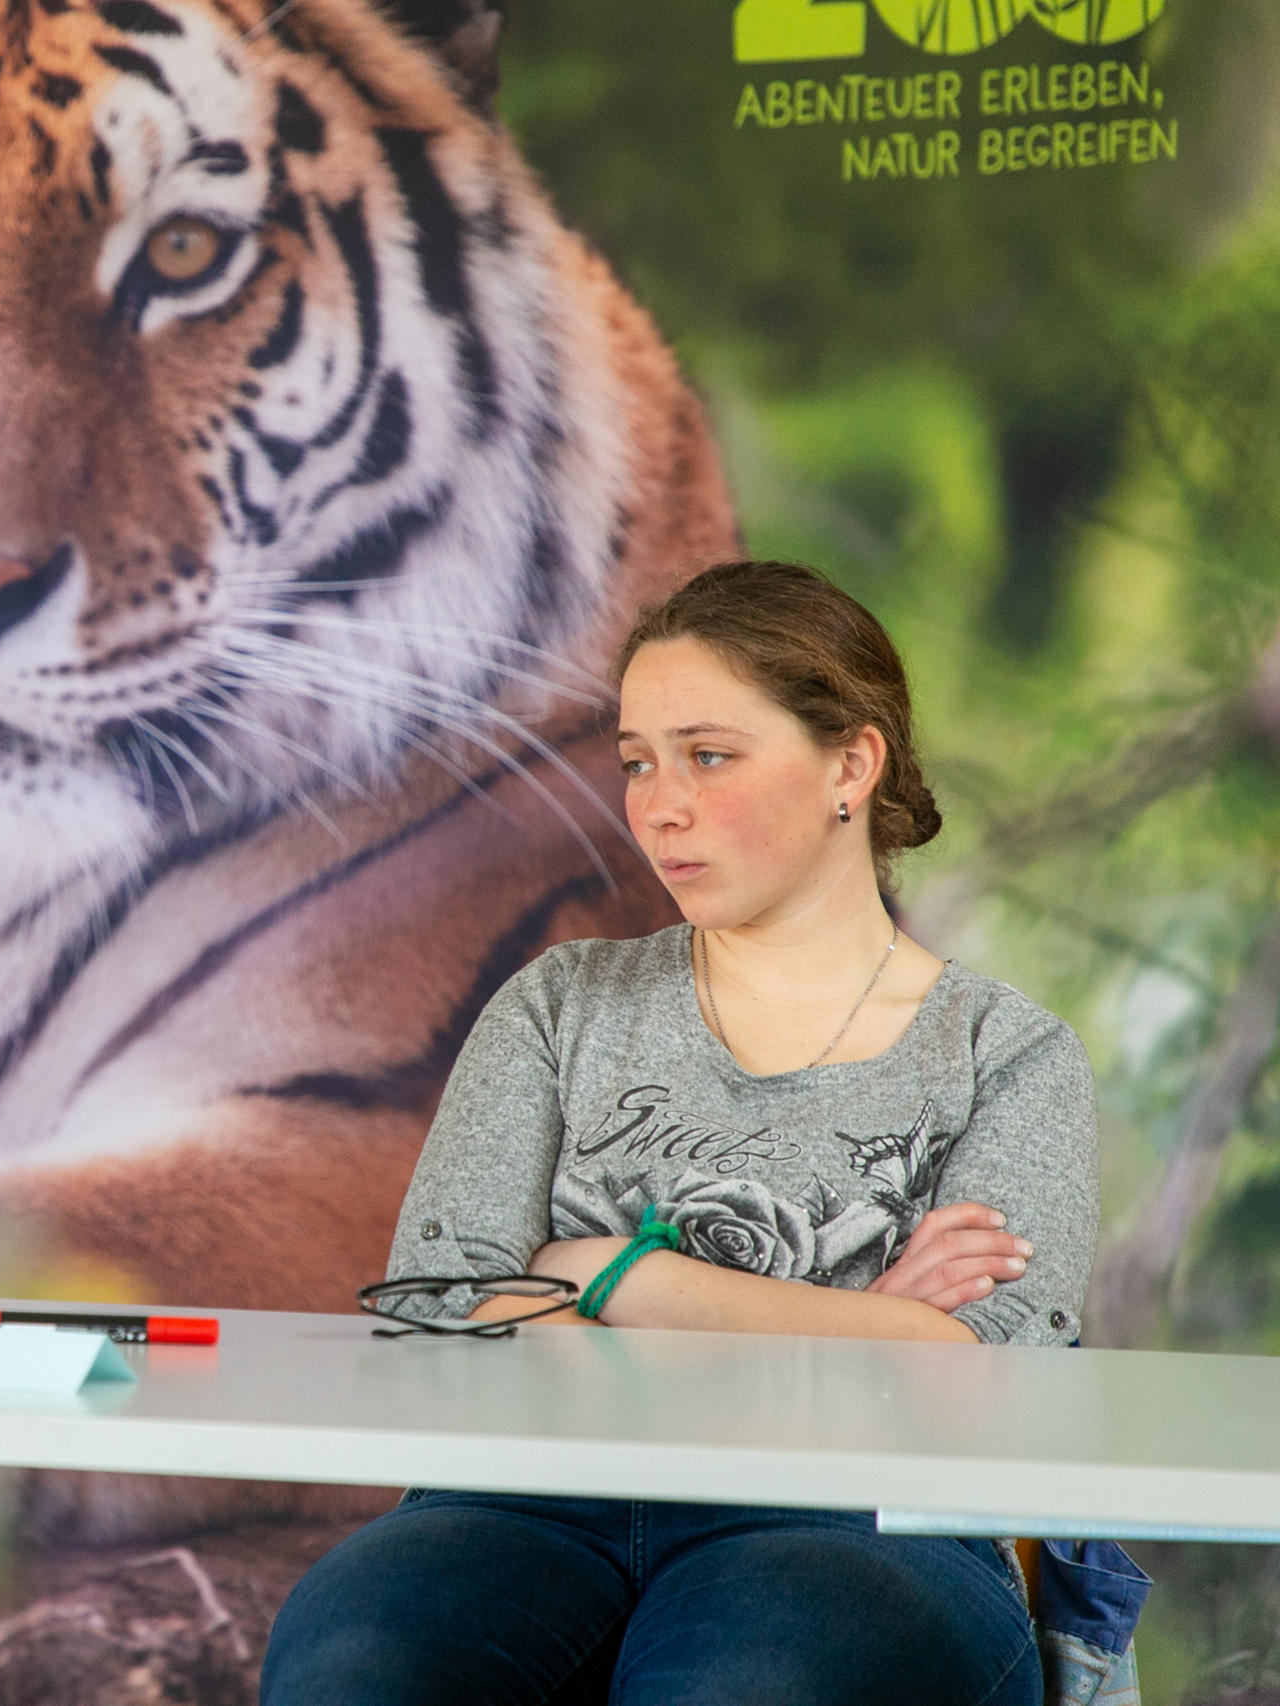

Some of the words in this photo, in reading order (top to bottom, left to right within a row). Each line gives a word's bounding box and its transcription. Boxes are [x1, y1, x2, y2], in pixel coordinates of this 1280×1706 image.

[734, 70, 961, 129] ABENTEUER
[978, 62, 1164, 114] ERLEBEN,
[841, 130, 960, 181] NATUR
[977, 119, 1178, 175] BEGREIFEN
